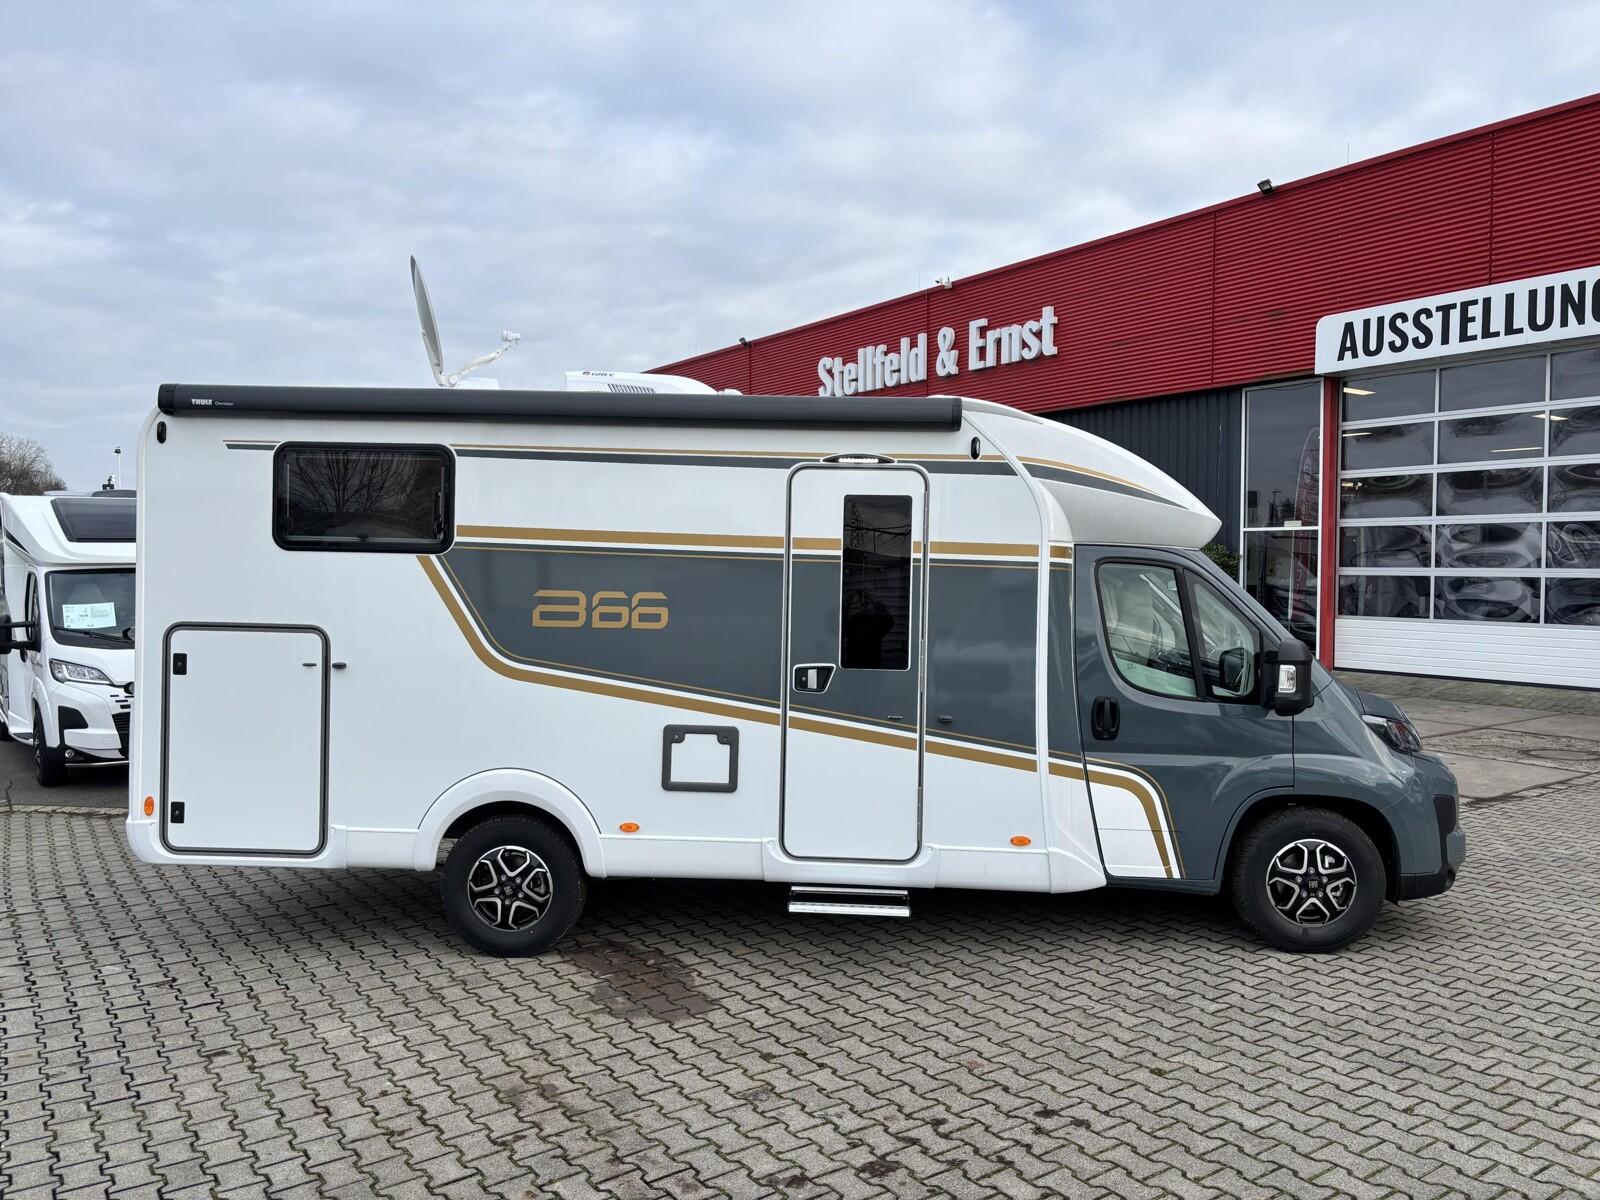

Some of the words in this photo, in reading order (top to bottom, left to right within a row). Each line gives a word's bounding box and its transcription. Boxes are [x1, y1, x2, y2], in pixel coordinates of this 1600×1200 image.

[818, 333, 928, 397] Stellfeld
[936, 327, 959, 377] &
[968, 305, 1059, 371] Ernst
[191, 398, 213, 406] THULE
